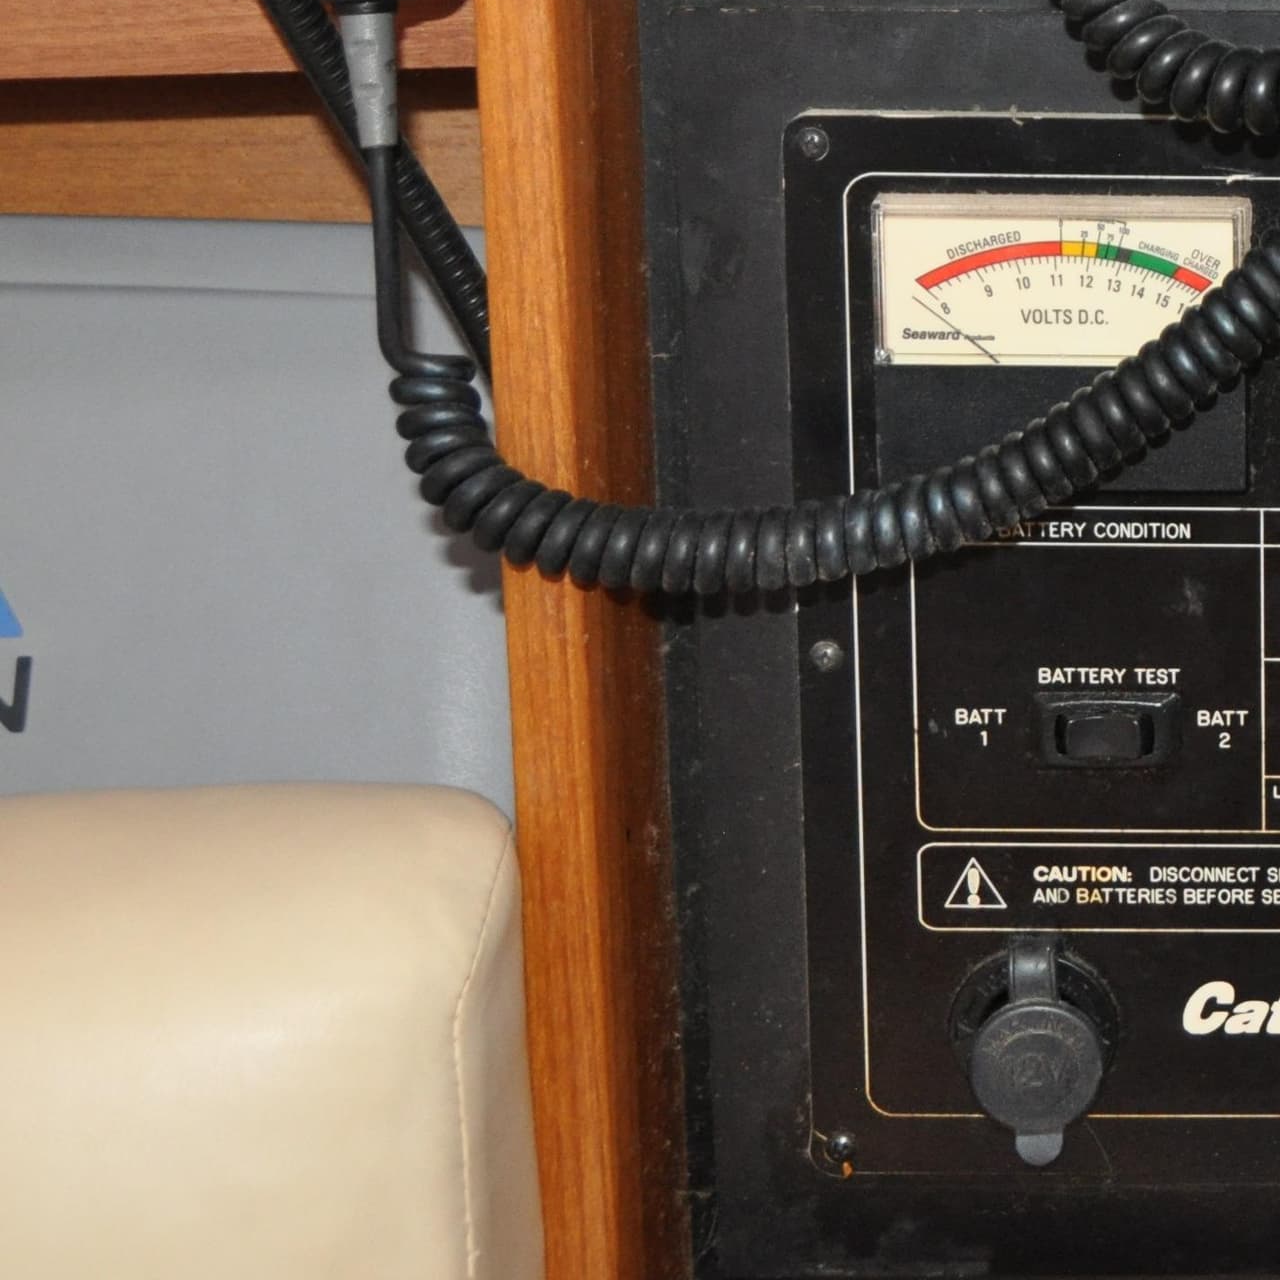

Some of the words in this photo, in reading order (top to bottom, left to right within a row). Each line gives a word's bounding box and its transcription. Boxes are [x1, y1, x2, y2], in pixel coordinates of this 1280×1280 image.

[945, 229, 1022, 261] DISCHARGED
[1020, 308, 1073, 325] VOLTS
[1077, 308, 1109, 326] D.C.
[901, 324, 964, 341] Seaward
[1093, 521, 1192, 540] CONDITION
[1032, 865, 1133, 883] CAUTION:
[1149, 865, 1261, 883] DISCONNECT
[1032, 887, 1070, 904] AND
[1075, 887, 1177, 905] BATTERIES
[1182, 887, 1255, 905] BEFORE
